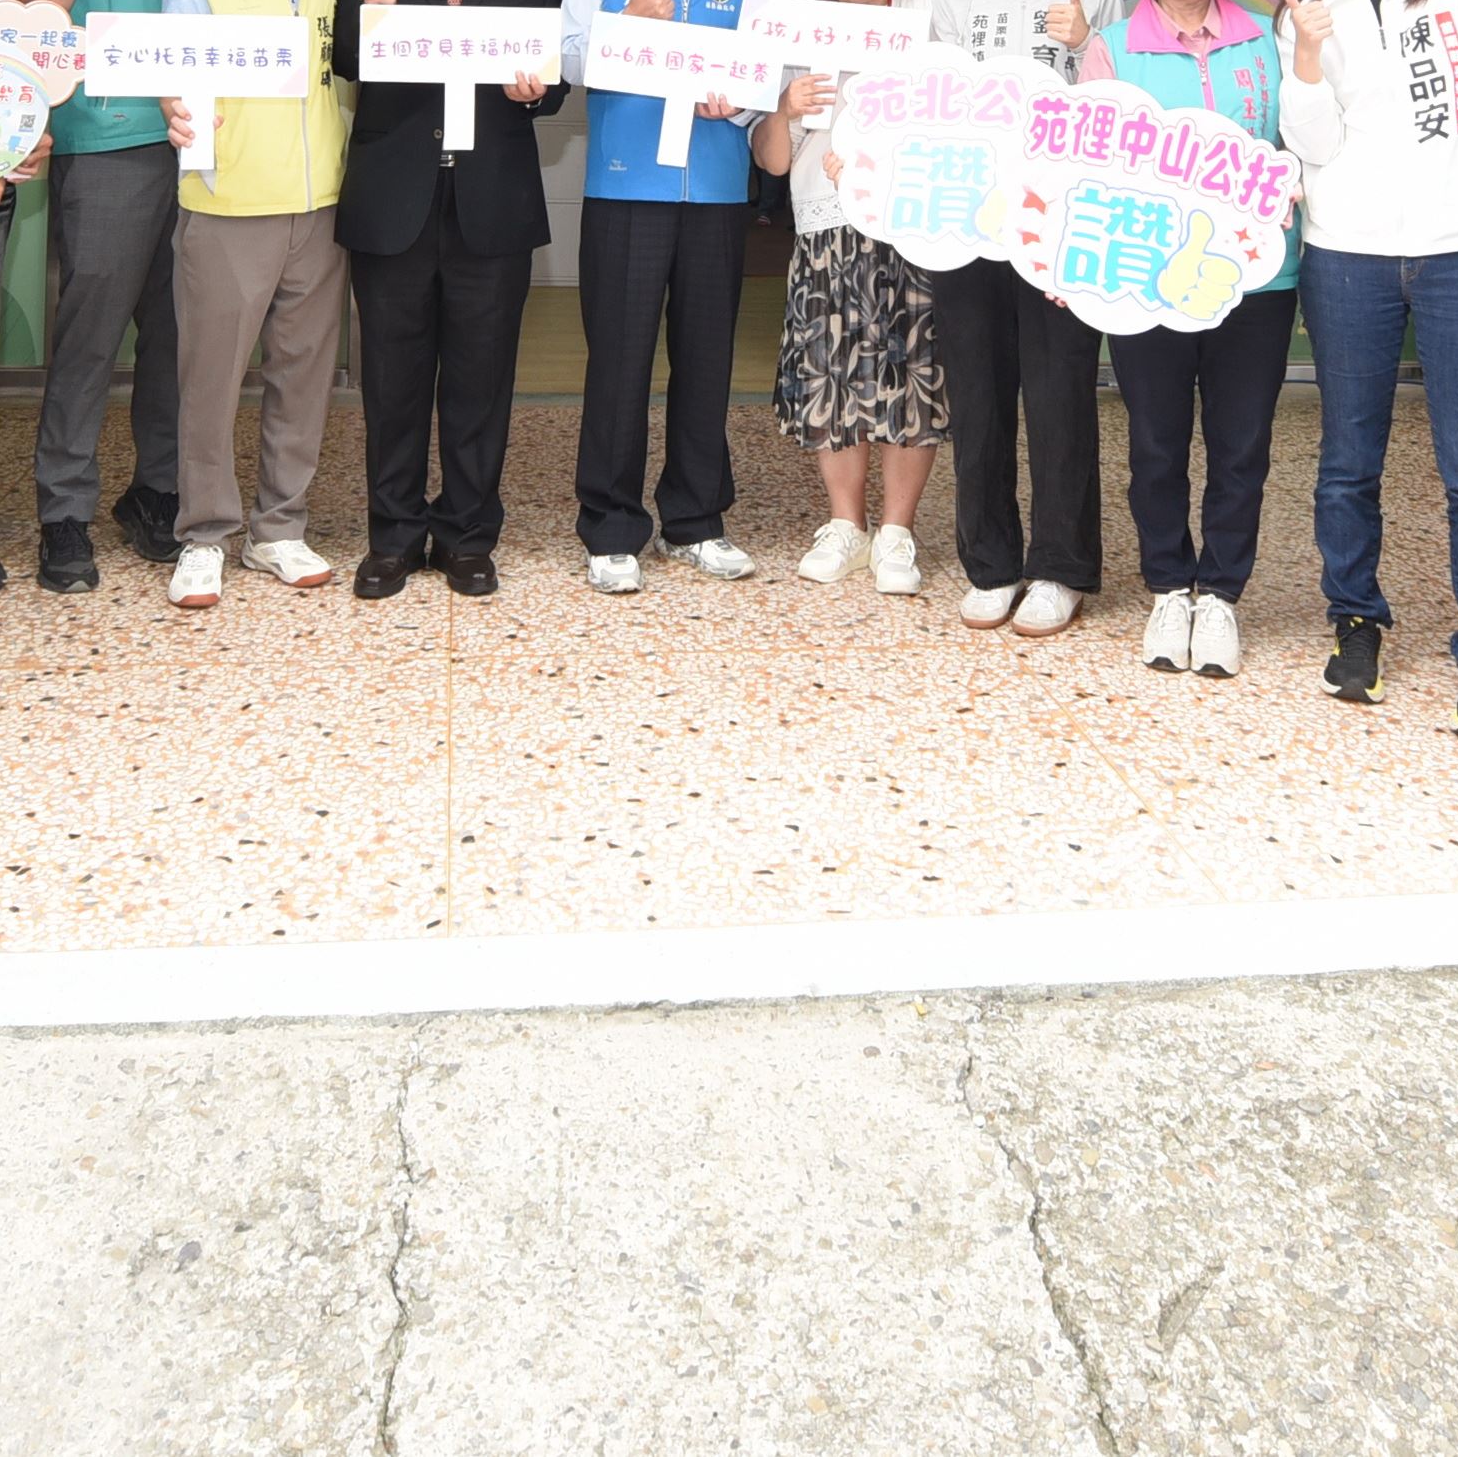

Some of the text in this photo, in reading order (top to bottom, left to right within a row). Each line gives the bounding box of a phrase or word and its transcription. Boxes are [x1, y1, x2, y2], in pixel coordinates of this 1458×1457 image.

[102, 43, 294, 68] 安心托育幸福苗栗
[371, 38, 544, 60] 生個寶貝幸福加倍
[1400, 14, 1450, 144] 陳品安
[855, 72, 1022, 129] 苑北公
[890, 142, 991, 235] 讚
[1027, 95, 1289, 219] 苑裡中山公托
[1063, 188, 1176, 304] 讚
